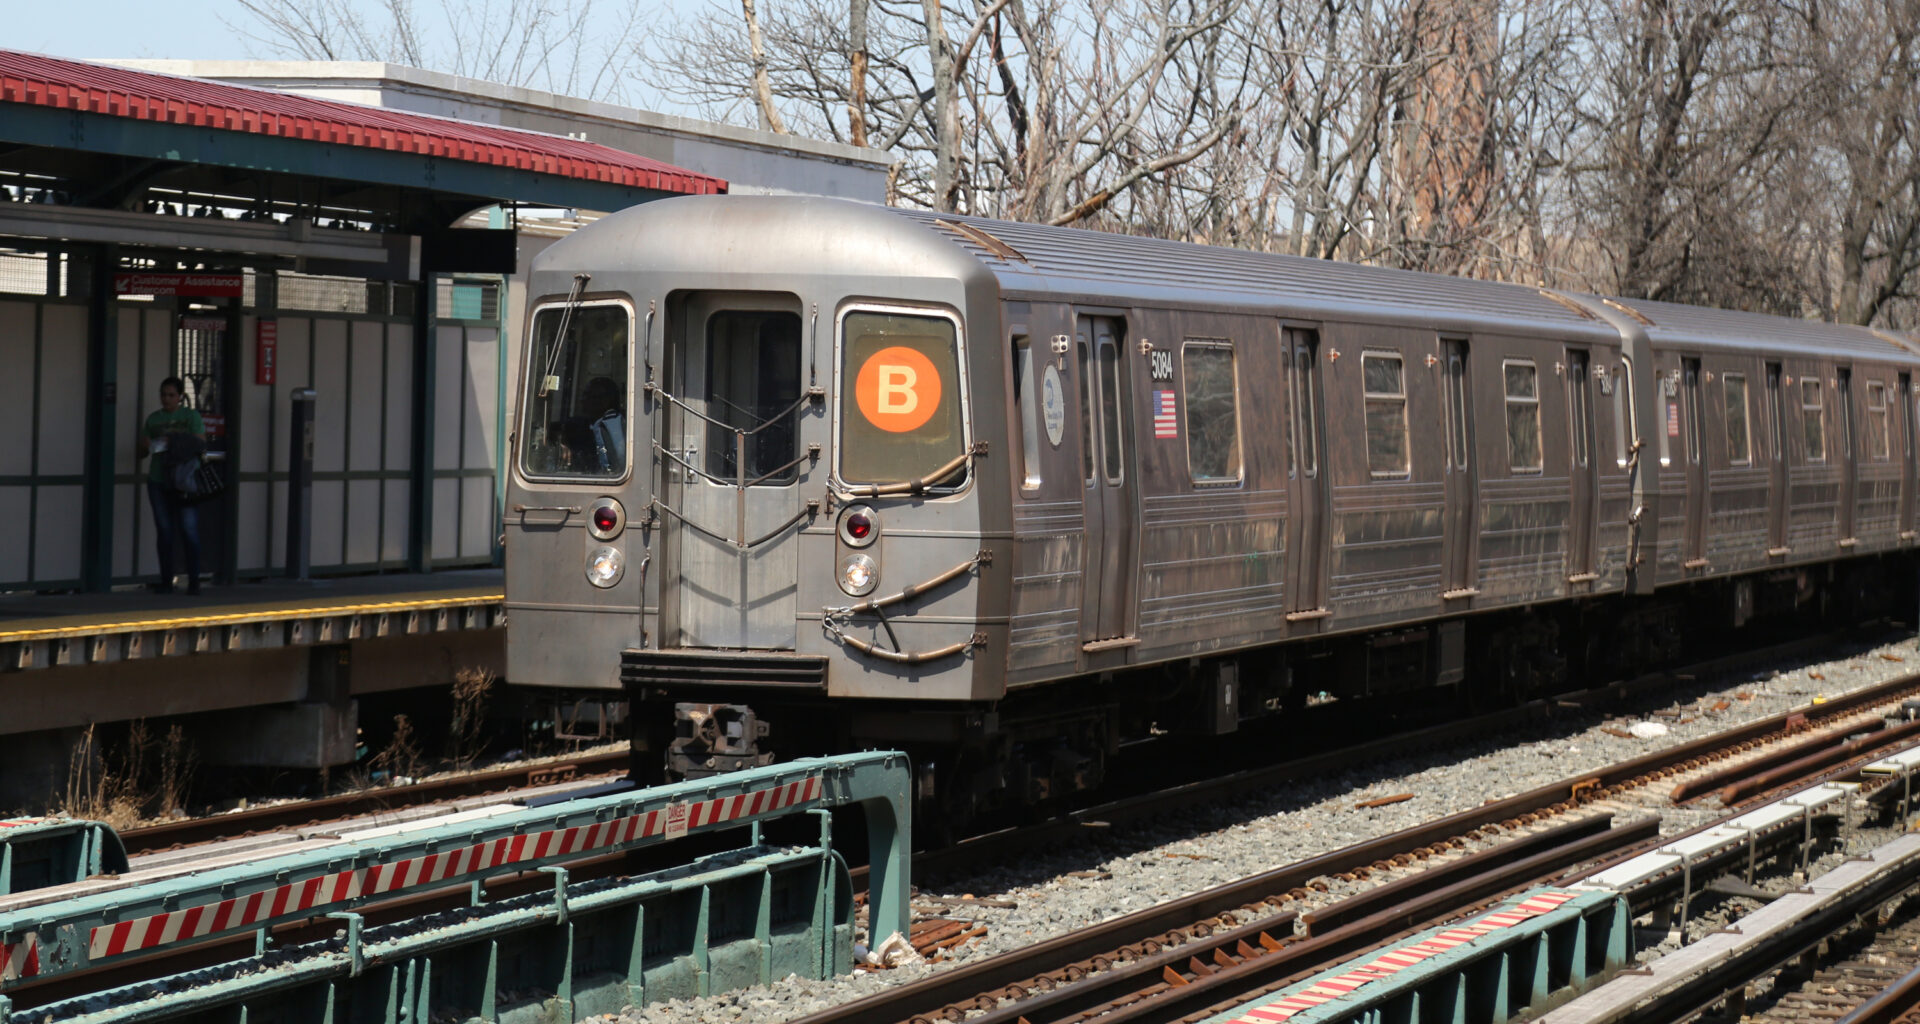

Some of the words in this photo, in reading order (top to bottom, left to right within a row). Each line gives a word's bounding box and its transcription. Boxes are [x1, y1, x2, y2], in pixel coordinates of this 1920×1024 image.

[131, 275, 180, 286] Customer
[184, 277, 240, 287] Assistance
[131, 286, 176, 295] Intercom
[1151, 351, 1173, 380] 5084
[878, 365, 919, 414] B
[668, 803, 686, 820] DANGER
